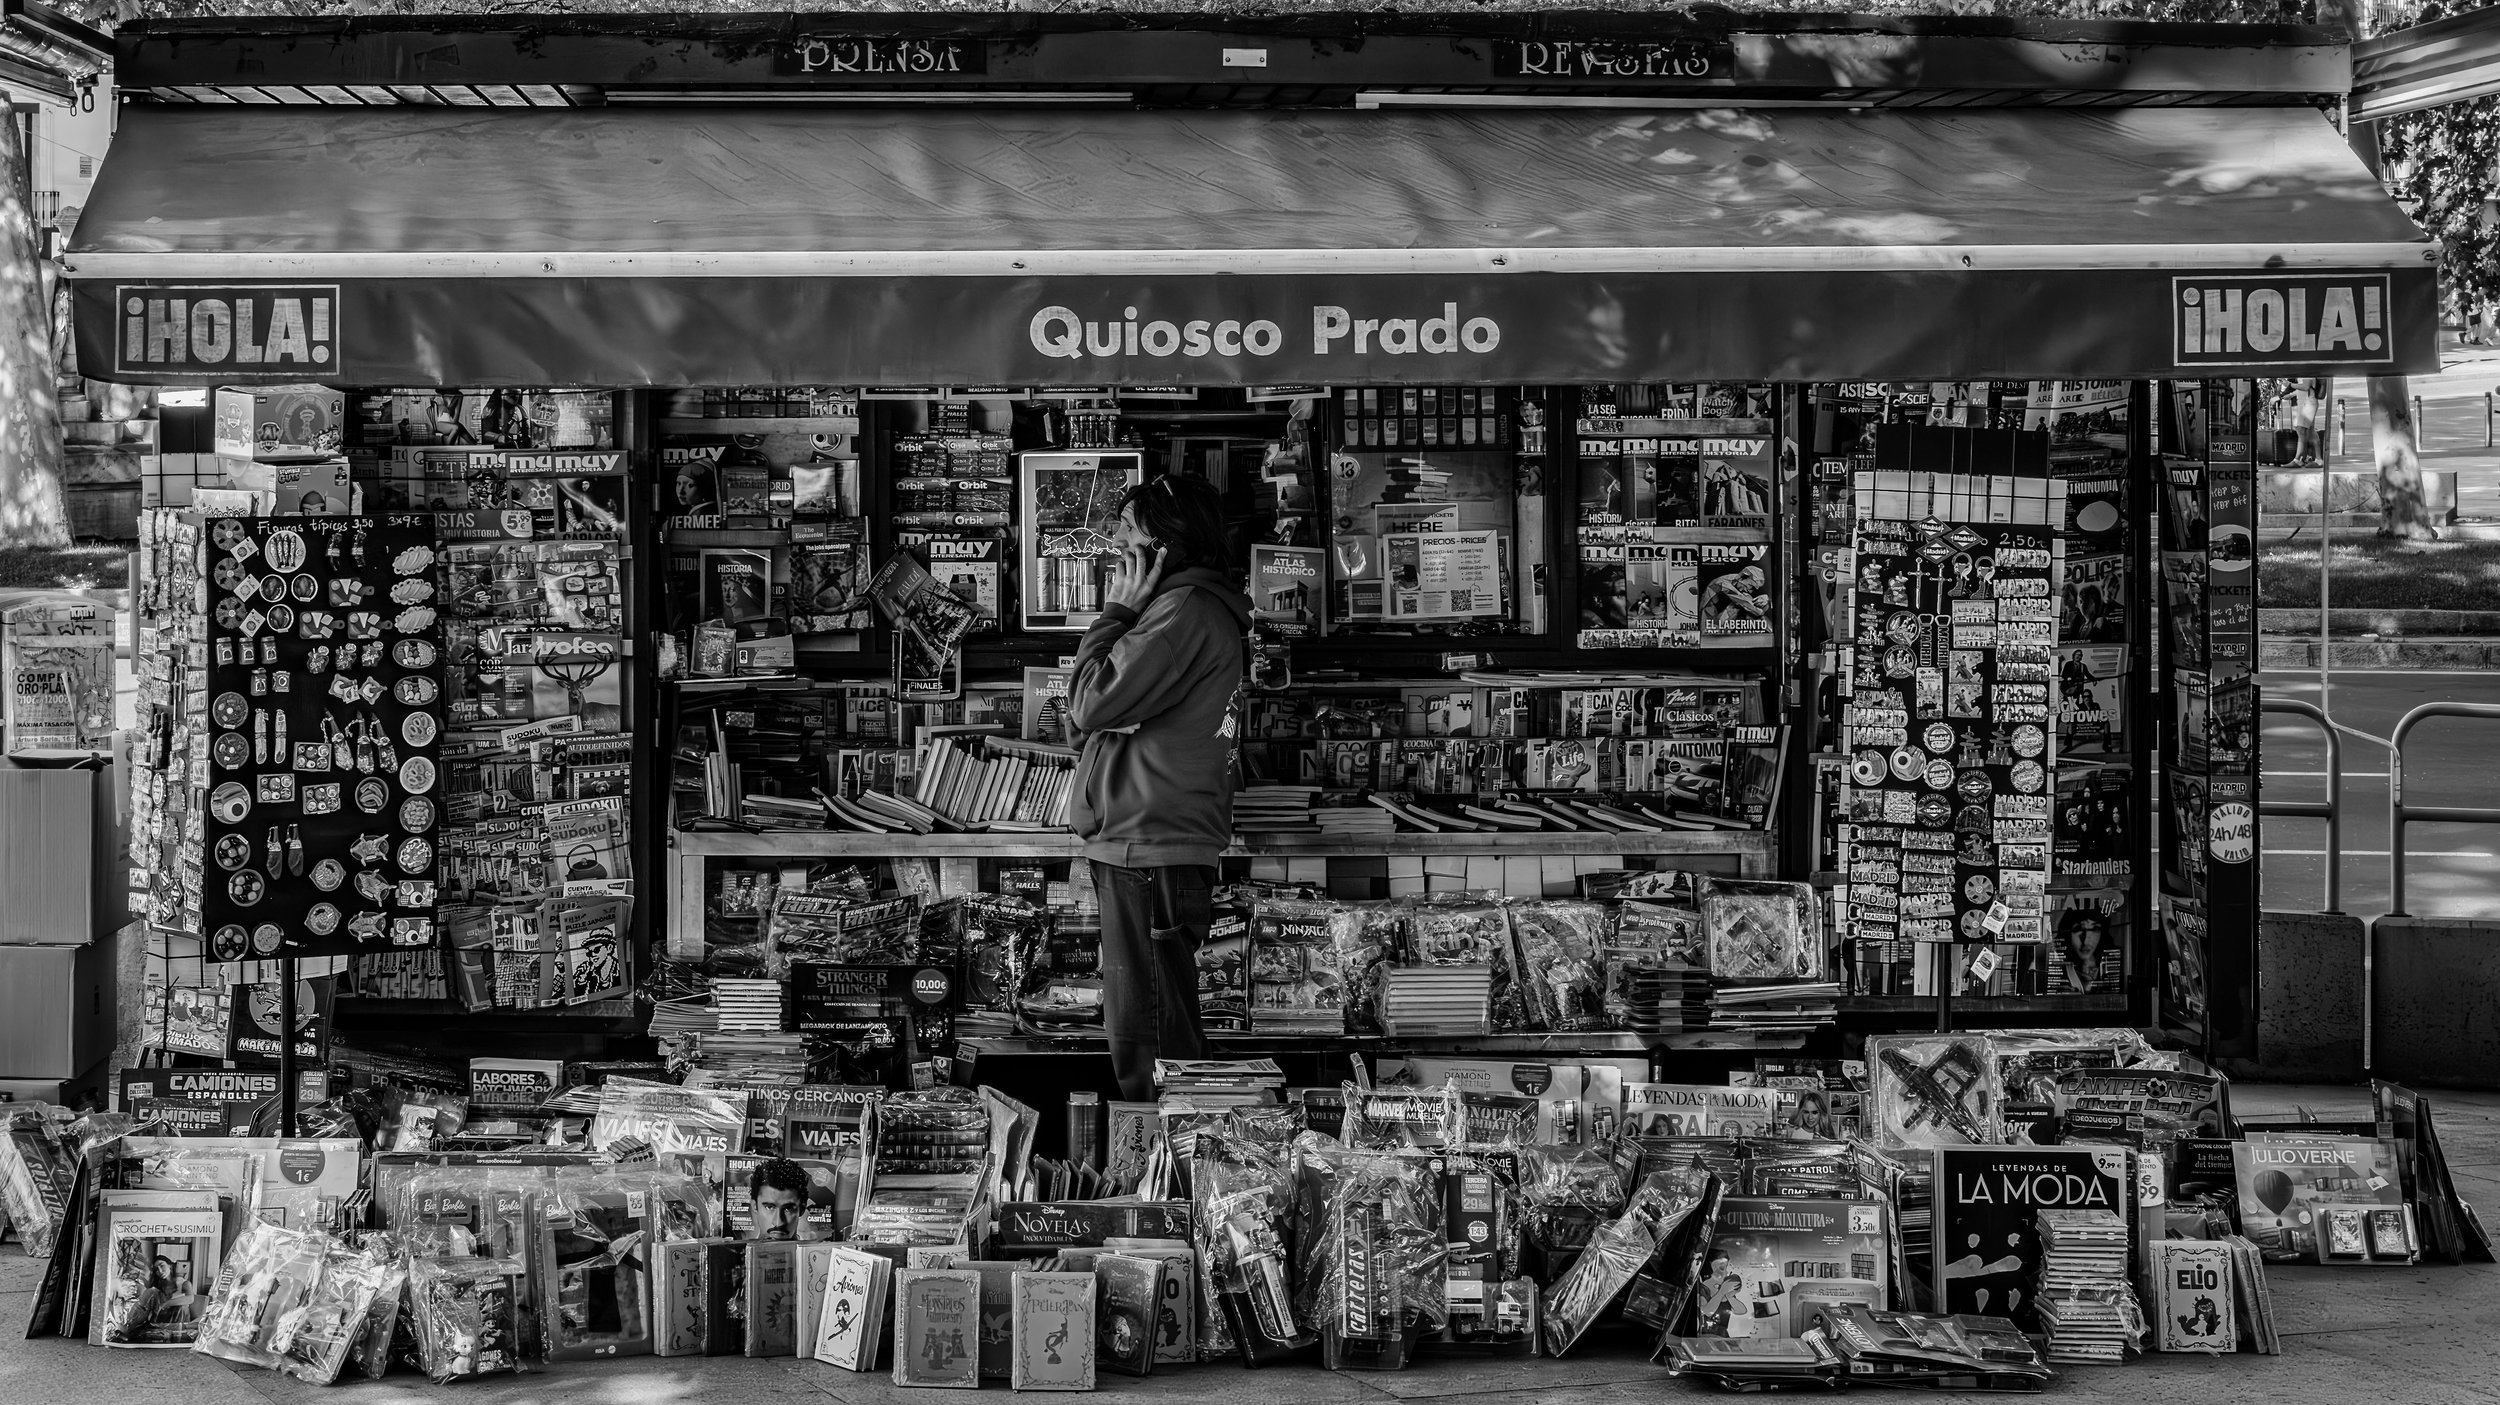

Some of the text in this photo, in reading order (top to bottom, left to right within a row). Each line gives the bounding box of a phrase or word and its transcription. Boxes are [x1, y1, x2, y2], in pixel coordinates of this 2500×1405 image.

[801, 39, 961, 73] PRENSA
[2183, 286, 2382, 353] ¡HOLA!
[126, 297, 331, 364] ¡HOLA!
[1029, 302, 1500, 360] Quiosco Prado
[663, 446, 726, 462] muy
[894, 443, 923, 453] Orbit
[1703, 439, 1766, 456] muy
[2212, 442, 2246, 453] MADRID
[555, 454, 621, 471] muy
[2173, 469, 2199, 484] muy
[896, 480, 988, 491] Orbit Orbit
[311, 519, 348, 533] típicas
[351, 518, 374, 531] 3,50
[955, 515, 984, 525] Orbit
[1392, 521, 1443, 533] HERE
[463, 529, 501, 538] HISTORIA
[1422, 536, 1487, 546] PRECIOS PRICES
[930, 541, 993, 559] muy
[1701, 545, 1769, 561] muy
[717, 564, 753, 573] HISTORIA
[1273, 557, 1306, 567] ATLAS
[2065, 558, 2122, 584] POLICE
[1706, 619, 1767, 630] EL LABERINTO
[535, 635, 614, 655] trofeo
[2212, 643, 2246, 653] MADRID
[910, 681, 943, 691] FINALES
[1666, 710, 1714, 723] Clásicos
[17, 720, 75, 728] MÁXIMA TASACIÓN
[551, 723, 573, 731] NUEVO
[506, 727, 541, 741] SUDOKU
[567, 740, 630, 751] AUTODEFINIDOS
[1561, 751, 1585, 766] Life
[2212, 782, 2246, 793] MADRID
[551, 824, 607, 842] SUDOKU
[2061, 858, 2131, 875] Starbenders
[1852, 871, 1900, 884] MADRID
[1015, 881, 1041, 891] HALLS
[1851, 890, 1898, 908] MADRID
[843, 896, 909, 930] RALLY
[1642, 916, 1673, 931] SPIDERMAN
[1209, 923, 1246, 939] POWER
[1862, 931, 1891, 939] MADRID
[2006, 931, 2032, 939] MADRID
[816, 969, 889, 987] STRANGER
[914, 979, 947, 991] 10,00€
[827, 983, 877, 995] THINGS
[800, 1022, 844, 1030] MEGAPACK DE
[473, 1071, 535, 1086] LABORES
[1444, 1071, 1491, 1081] DIAMOND
[169, 1075, 277, 1092] CAMIONES
[1526, 1082, 1540, 1095] 1€
[187, 1090, 258, 1100] ESPAÑOLES
[794, 1089, 874, 1105] CERCANOS
[1624, 1089, 1768, 1109] LEYENDAS MODA
[1368, 1101, 1442, 1119] MARVEL MOVIE
[2076, 1097, 2129, 1112] Oliver
[2143, 1099, 2192, 1114] Benji
[138, 1108, 221, 1124] CAMIONES
[801, 1130, 862, 1147] VIAJES
[2198, 1153, 2230, 1162] La flecha
[2252, 1145, 2357, 1166] JULIO VERNE
[729, 1160, 755, 1171] ¡HOLA!
[1800, 1164, 1835, 1175] PATROL
[1992, 1164, 2067, 1173] LEYENDAS DE
[2194, 1161, 2233, 1170] del tiempo
[1957, 1173, 2109, 1206] LA MODA
[442, 1198, 466, 1212] Barbie
[498, 1199, 521, 1212] Barbie
[546, 1203, 569, 1217] Barbie
[1040, 1205, 1065, 1217] Disney
[1768, 1202, 1786, 1212] Disney
[1014, 1211, 1092, 1238] NOVELAS
[1727, 1212, 1827, 1229] CUENTOS MINIATURA
[116, 1224, 167, 1234] CROCHET
[174, 1224, 216, 1234] SUSIMIU
[1023, 1235, 1073, 1243] INOLVIDABLES
[2176, 1263, 2218, 1290] ELIO
[832, 1274, 865, 1297] Aviones
[1348, 1249, 1370, 1337] carreras
